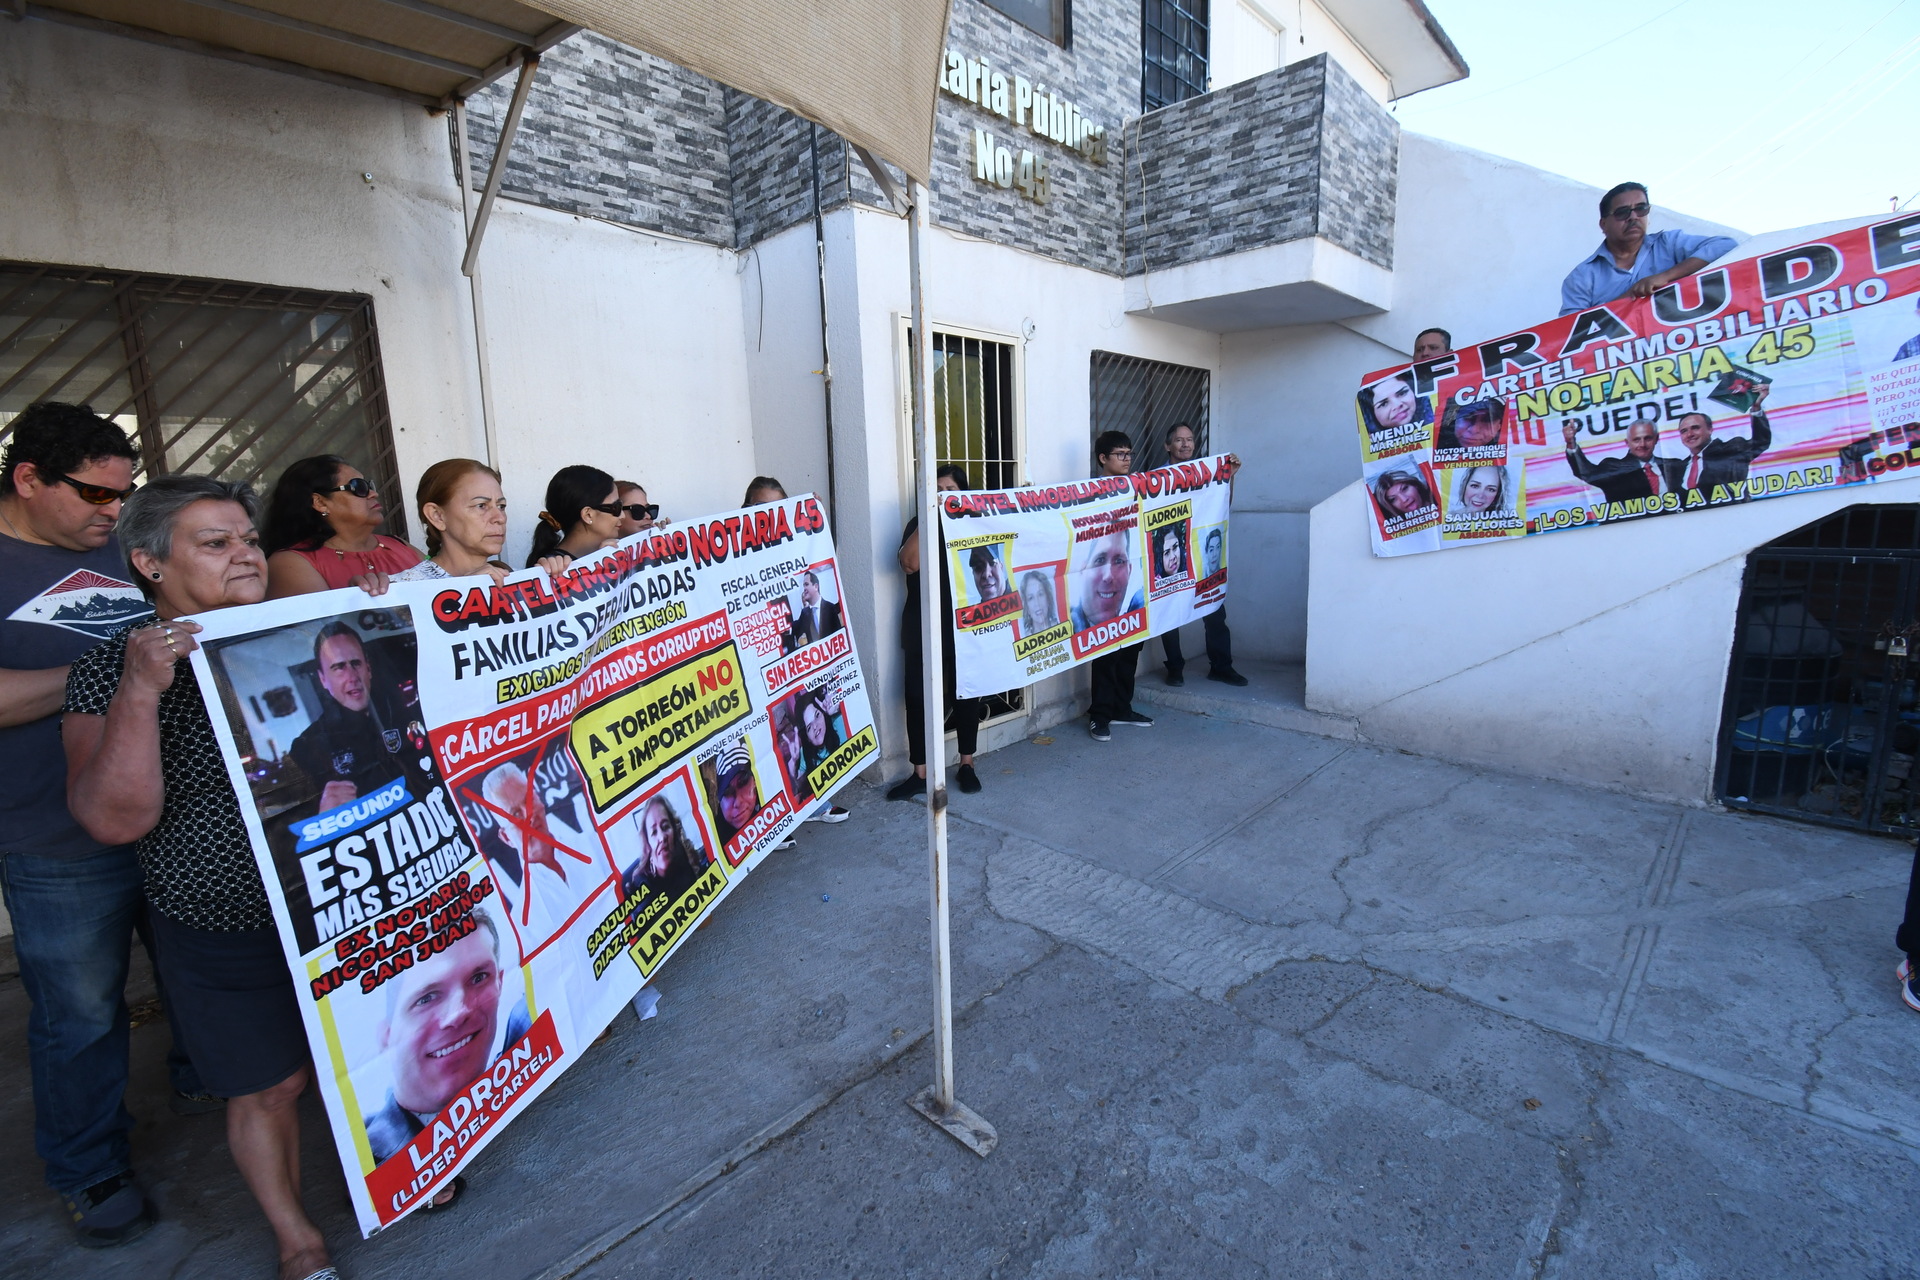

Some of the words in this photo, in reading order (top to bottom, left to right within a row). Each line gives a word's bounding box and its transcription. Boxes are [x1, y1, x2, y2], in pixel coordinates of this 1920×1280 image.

[1015, 75, 1108, 165] Pública
[975, 129, 1013, 188] No
[1018, 149, 1051, 203] 45
[1411, 211, 1920, 397] FRAUDE
[1455, 360, 1585, 406] CARTEL
[1594, 277, 1888, 371] INMOBILIARIO
[1516, 345, 1735, 421] NOTARIA
[1746, 323, 1816, 365] 45
[1870, 372, 1888, 383] ME
[1890, 363, 1920, 379] QUIT
[1875, 391, 1905, 405] PERO
[1890, 412, 1916, 424] CON
[1370, 420, 1425, 443] WENDY
[1370, 431, 1431, 454] MARTINEZ
[1378, 442, 1423, 459] ASESORA
[1434, 447, 1466, 455] VICTOR
[1467, 444, 1507, 453] ENRIQUE
[1433, 453, 1460, 463] DIAZ
[1462, 450, 1507, 461] FLORES
[1444, 460, 1493, 469] VENDEDOR
[944, 492, 1019, 520] CARTEL
[1014, 476, 1130, 513] INMOBILIARIO
[1129, 460, 1212, 501] NOTARIA
[1591, 492, 1681, 522] VAMOS
[1685, 488, 1707, 508] A
[1710, 465, 1834, 503] AYUDAR!
[1071, 511, 1110, 529] NOTARIO
[1147, 504, 1189, 527] LADRONA
[1383, 515, 1404, 527] ANA
[1405, 503, 1438, 520] MARIA
[1385, 511, 1440, 534] GUERRERO
[1391, 520, 1441, 538] VENDEDORA
[1443, 521, 1473, 533] DIAZ
[1475, 518, 1524, 531] FLORES
[1445, 509, 1519, 523] SANJUANA
[1459, 530, 1507, 540] ASESORA
[550, 528, 688, 610] INMOBILIARIO
[688, 505, 793, 571] NOTARIA
[793, 497, 825, 536] 45
[946, 538, 974, 549] ENRIQUE
[975, 536, 990, 546] DIAZ
[991, 533, 1019, 542] FLORES
[721, 573, 758, 597] FISCAL
[759, 555, 808, 582] GENERAL
[726, 598, 742, 615] DE
[742, 577, 799, 607] COAHUILA
[451, 619, 580, 681] FAMILIAS
[575, 566, 696, 641] DEFRAUDADAS
[733, 600, 791, 637] DENUNCIA
[961, 595, 1019, 624] LADRON
[497, 652, 584, 705] EXIGIMOS
[595, 600, 688, 660] INTERVENCIÓN
[738, 623, 777, 650] DESDE
[776, 617, 792, 634] EL
[756, 634, 782, 657] 2020
[1017, 626, 1068, 656] LADRONA
[1077, 614, 1141, 652] LADRON
[766, 659, 788, 691] SIN
[787, 633, 847, 679] RESOLVER
[827, 669, 858, 694] MARTINEZ
[439, 712, 532, 774] ¡CÁRCEL
[537, 688, 578, 727] PARA
[578, 659, 647, 705] NOTARIOS
[648, 617, 727, 672] CORRUPTOS!
[588, 732, 608, 760] A
[605, 679, 697, 744] TORREÓN
[697, 658, 733, 697] NO
[832, 683, 861, 705] ESCOBAR
[600, 758, 628, 789] LE
[628, 688, 740, 775] IMPORTAMOS
[696, 738, 728, 763] ENRIQUE
[728, 727, 744, 743] DIAZ
[743, 712, 769, 735] FLORES
[811, 733, 873, 792] LADRONA
[301, 784, 405, 842] SEGUNDO
[728, 797, 786, 860] LADRON
[753, 814, 795, 853] VENDEDOR
[300, 801, 457, 908] ESTADO
[313, 884, 383, 944] MÁS
[387, 837, 470, 905] SEGURO
[335, 925, 374, 962] EX
[375, 870, 471, 938] NOTARIO
[586, 883, 651, 957] SANJUANA
[592, 936, 625, 981] DIAZ
[622, 891, 670, 946] FLORES
[637, 871, 722, 966] LADRONA
[310, 921, 430, 1000] NICOLAS
[431, 875, 495, 934] MUÑOZ
[360, 952, 415, 995] SAN
[416, 913, 478, 963] JUAN
[407, 1036, 533, 1172] LADRON
[391, 1145, 457, 1212] (LIDER
[457, 1111, 491, 1146] DEL
[490, 1044, 554, 1112] CARTEL)
